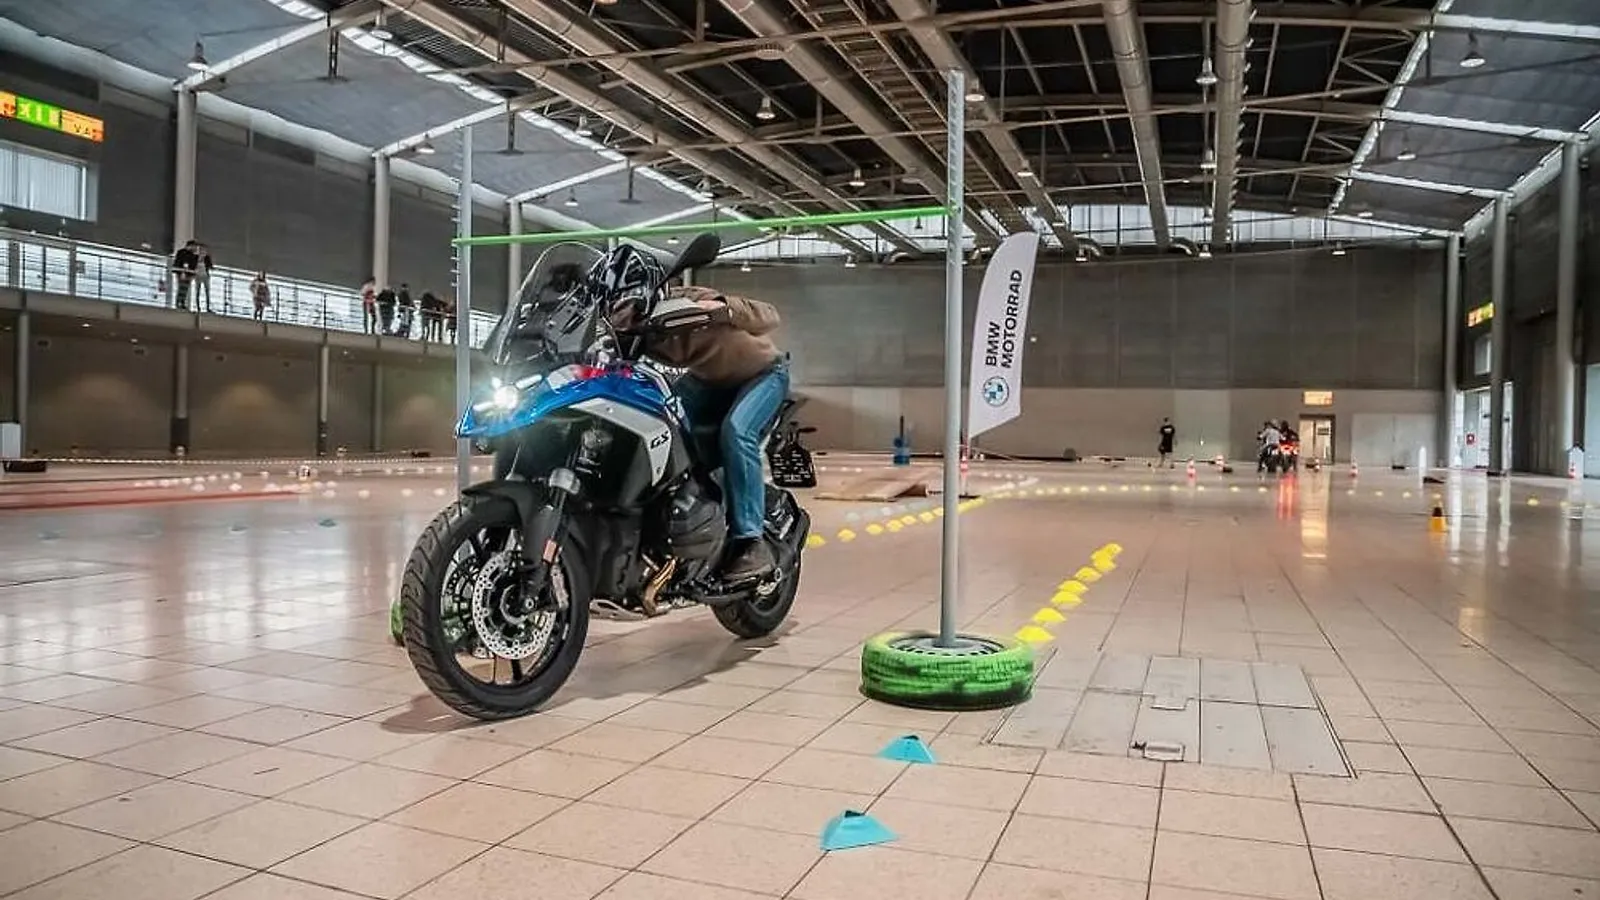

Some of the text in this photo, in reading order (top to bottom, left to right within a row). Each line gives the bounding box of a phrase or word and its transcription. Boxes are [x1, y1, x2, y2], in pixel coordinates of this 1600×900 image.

[1001, 270, 1022, 368] MOTORRAD
[985, 321, 1000, 367] BMW
[650, 431, 669, 449] GS
